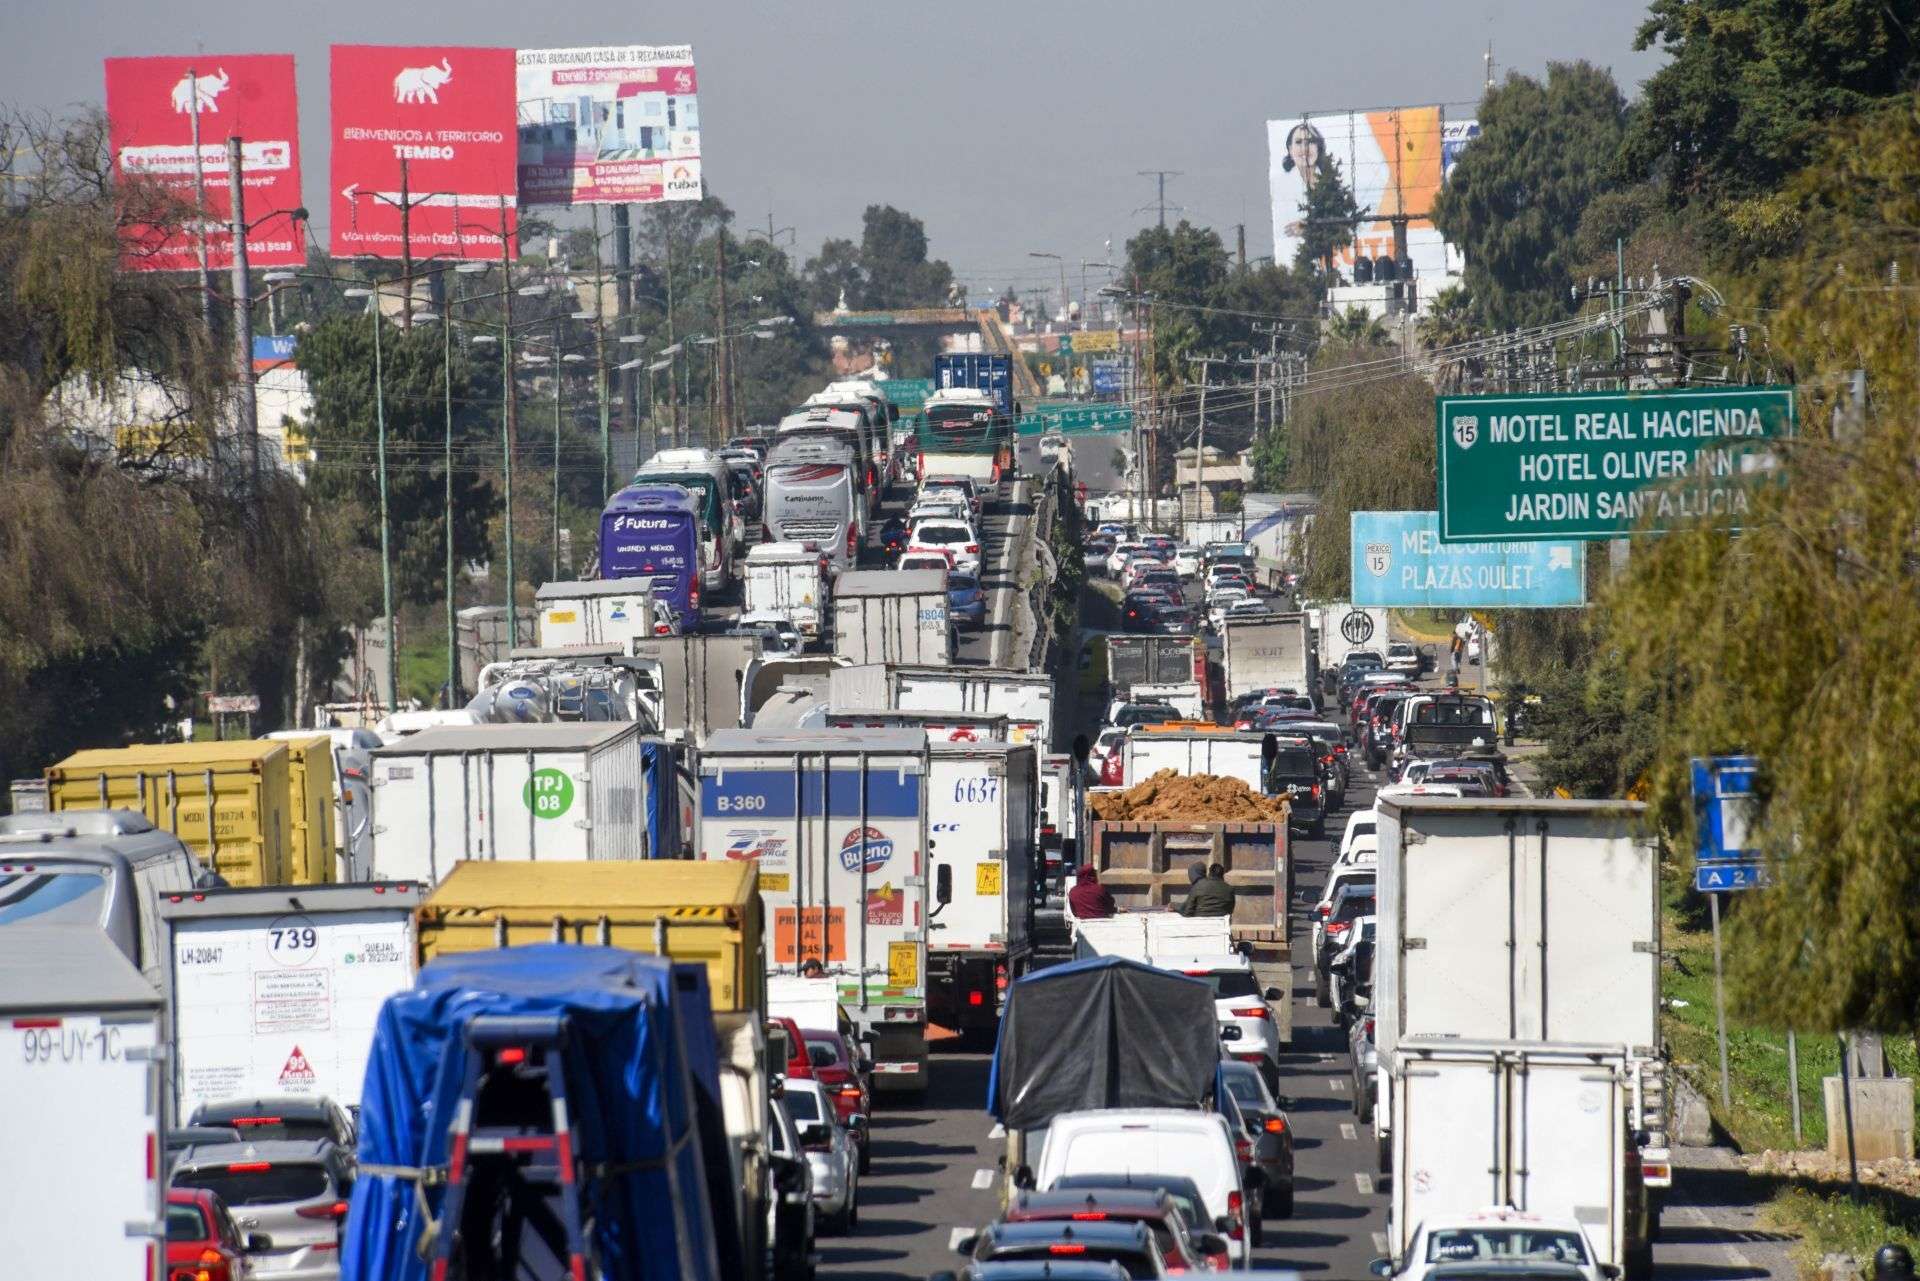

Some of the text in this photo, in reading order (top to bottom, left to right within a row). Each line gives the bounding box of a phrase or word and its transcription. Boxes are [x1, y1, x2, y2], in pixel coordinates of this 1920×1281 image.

[343, 128, 503, 144] BIENVENIDOS A TERRITORIO
[393, 144, 455, 159] TEMBO
[1490, 408, 1764, 443] MOTEL REAL HACIENDA
[1458, 426, 1475, 443] 15
[1520, 448, 1733, 482] HOTEL OLIVER INN
[1505, 493, 1590, 522] JARDIN
[1596, 490, 1673, 520] SANTA
[626, 518, 668, 529] Futura
[1374, 557, 1384, 570] 15
[1402, 565, 1534, 590] PLAZAS OULET
[534, 776, 563, 792] TPJ
[954, 777, 998, 803] 6637
[538, 795, 561, 811] 08
[717, 795, 766, 811] B-360
[843, 844, 891, 867] Bueno
[1733, 870, 1745, 884] 2
[269, 928, 317, 951] 739
[804, 930, 816, 939] AL
[787, 945, 834, 954] RBASR
[24, 1026, 121, 1063] 99-UY-1C
[288, 1056, 305, 1070] 95
